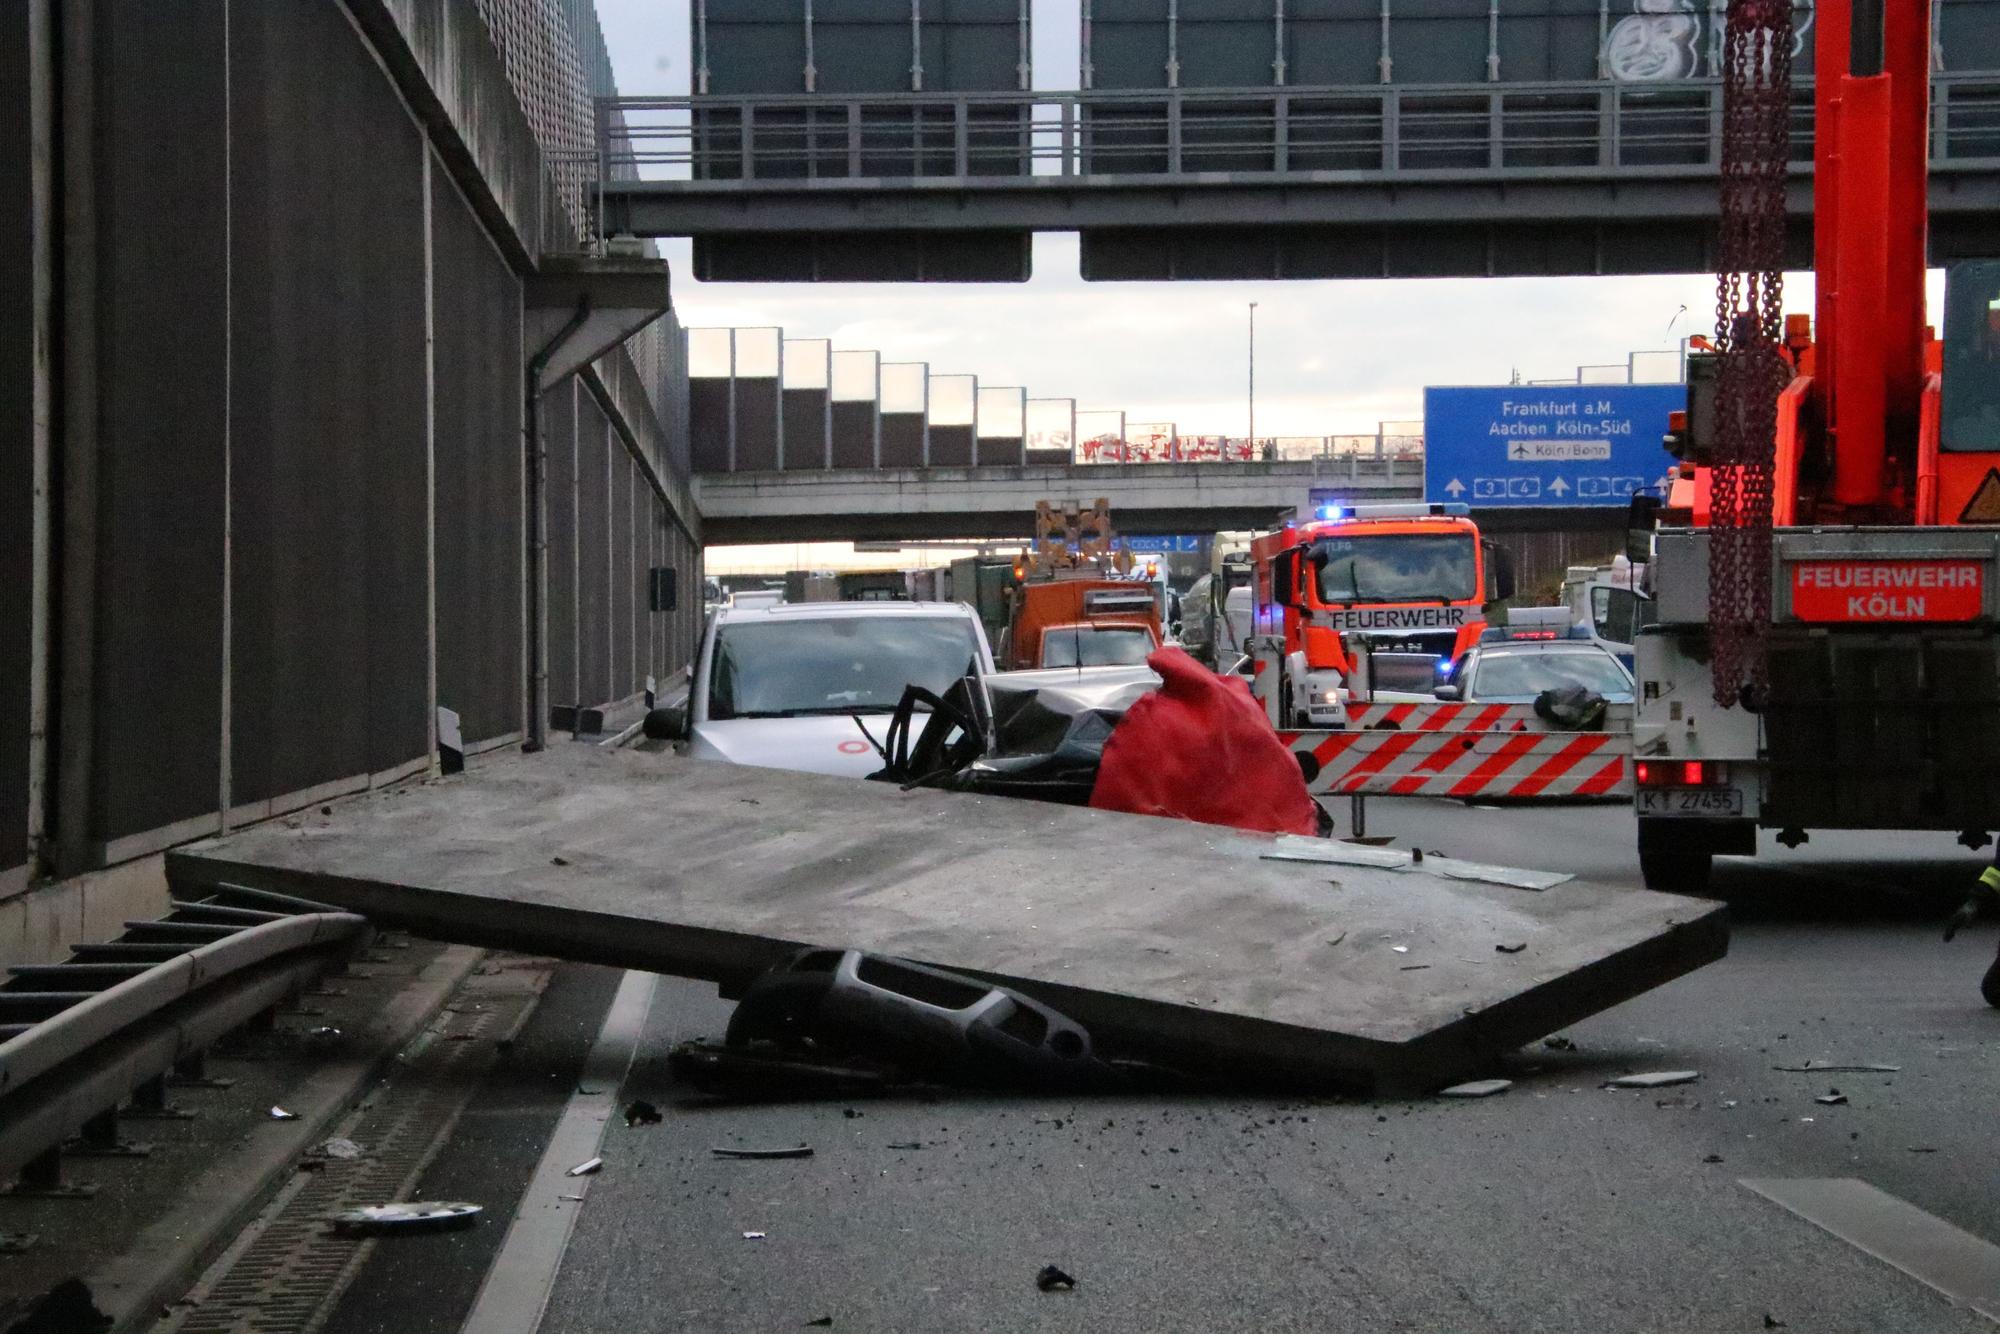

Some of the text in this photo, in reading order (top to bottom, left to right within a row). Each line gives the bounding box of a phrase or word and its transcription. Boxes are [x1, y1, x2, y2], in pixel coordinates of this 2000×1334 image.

[1503, 401, 1615, 416] Frankfurt a.M.
[1488, 420, 1631, 436] Aachen Köln-Süd
[1536, 443, 1607, 456] Köln/Bonn
[1799, 566, 1977, 588] FEUERWEHR
[1848, 592, 1926, 617] KÖLN
[1331, 608, 1464, 629] FEUERWEHR
[1644, 792, 1656, 809] K
